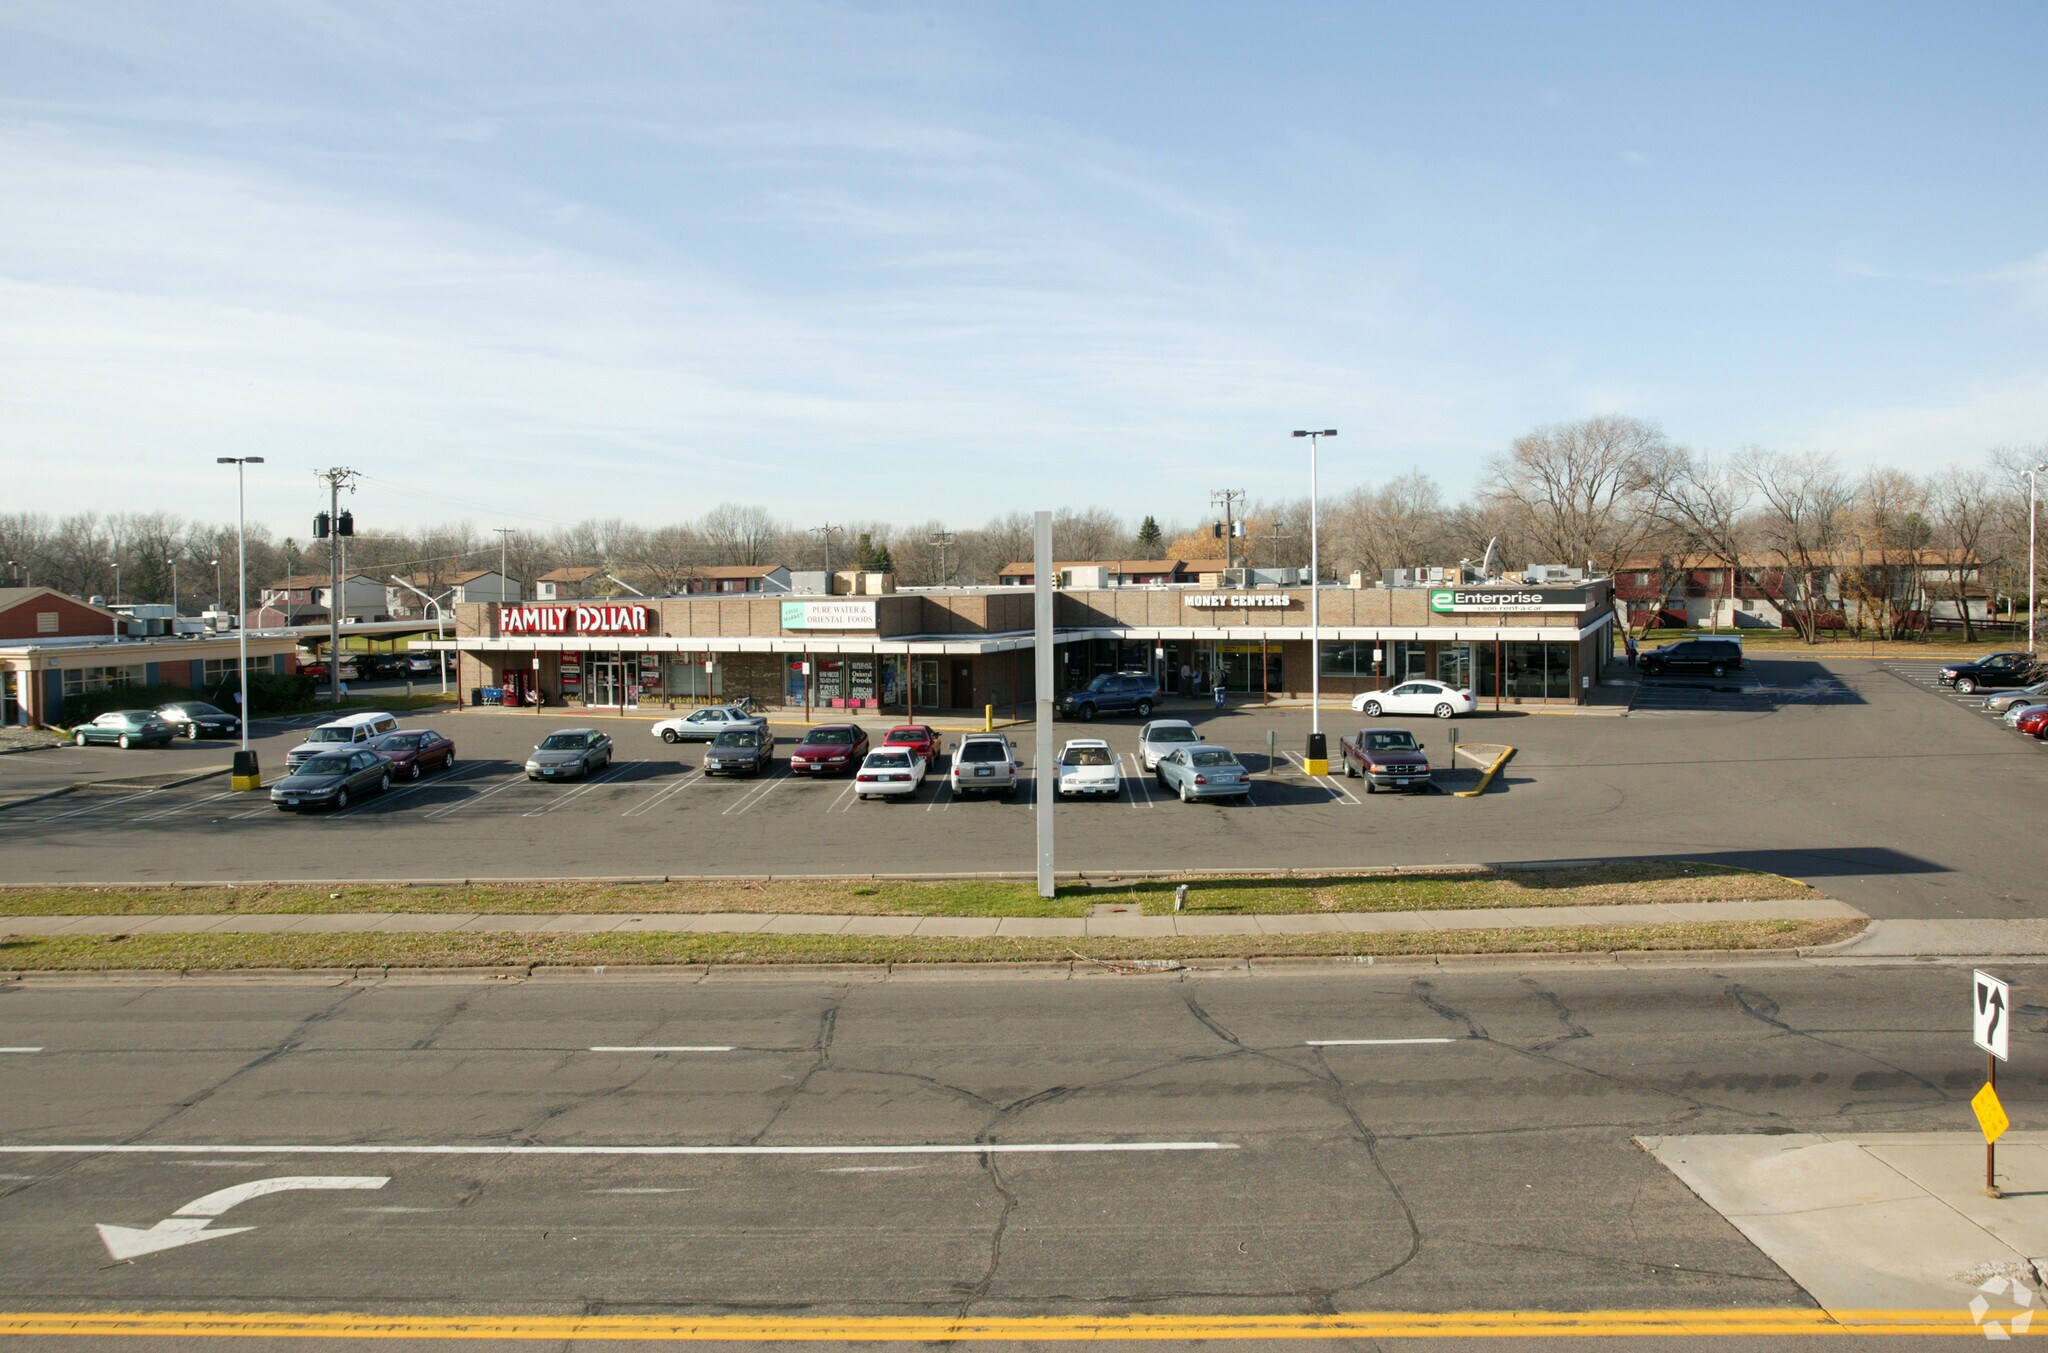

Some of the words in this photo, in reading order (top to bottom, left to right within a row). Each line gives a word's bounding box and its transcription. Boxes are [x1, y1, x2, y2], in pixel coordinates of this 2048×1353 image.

[1184, 595, 1227, 606] MONEY
[1230, 595, 1290, 606] CENTERS
[1455, 591, 1542, 604] Enterprise
[500, 608, 568, 631] FAMILY
[575, 605, 647, 631] DOLLAR
[783, 612, 804, 622] MARKET
[807, 615, 845, 623] ORIENTAL
[847, 615, 873, 623] FOODS
